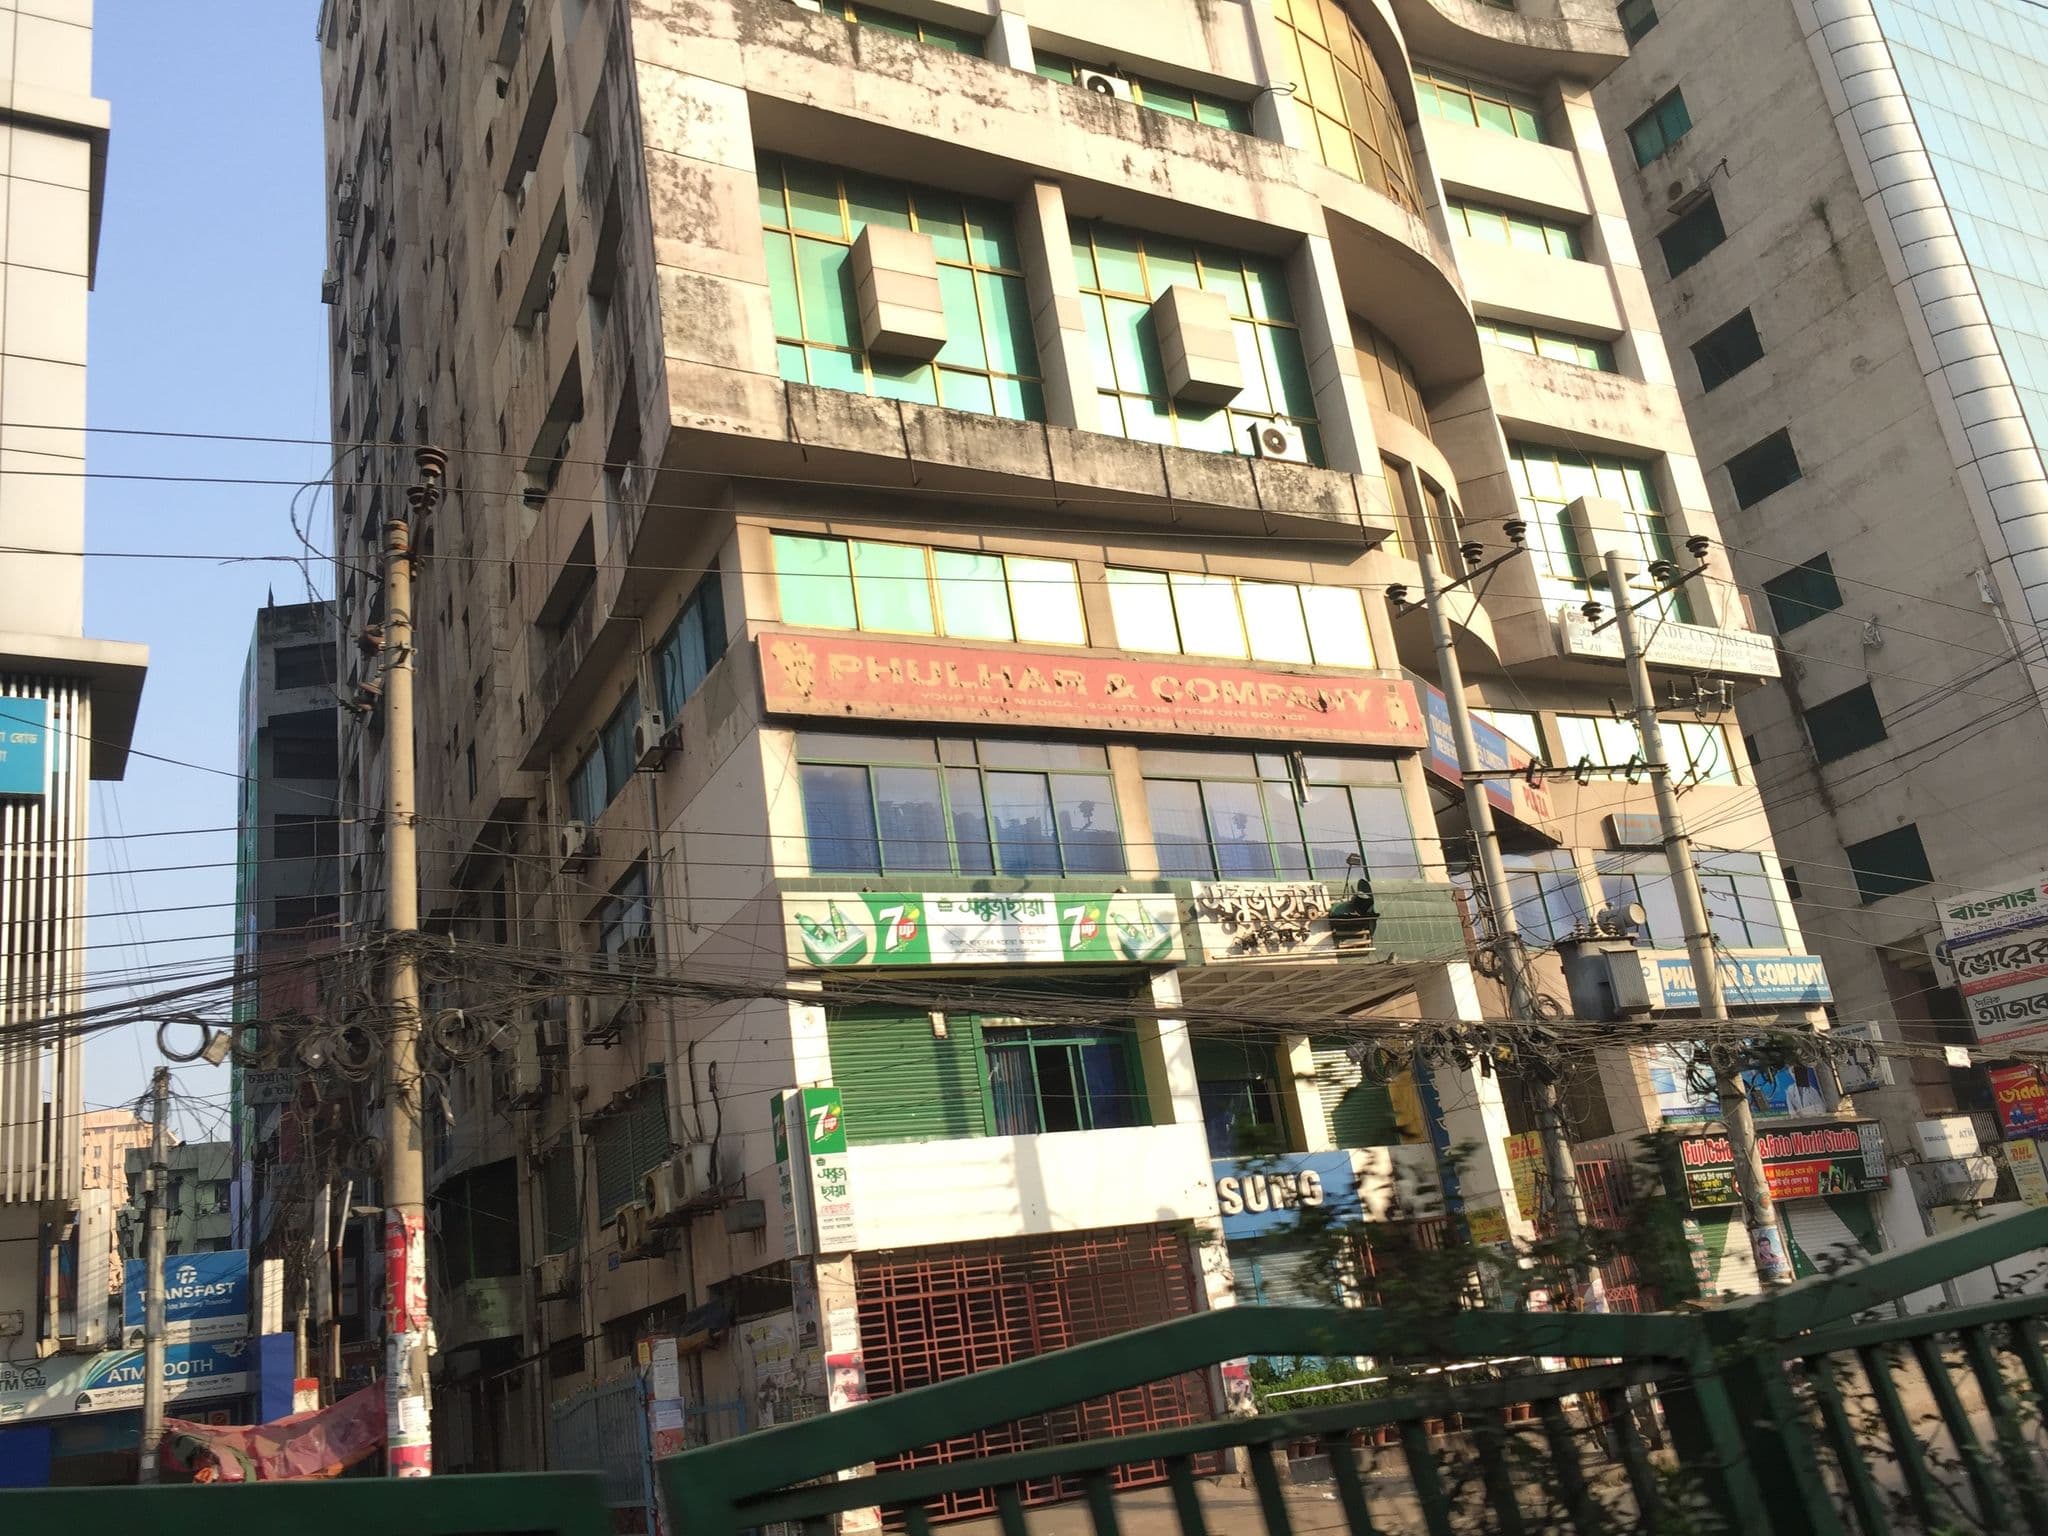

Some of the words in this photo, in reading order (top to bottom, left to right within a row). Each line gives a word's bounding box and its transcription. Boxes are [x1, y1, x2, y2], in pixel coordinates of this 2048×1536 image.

[828, 653, 1089, 696] PHULHAR
[1104, 672, 1138, 699] &
[1150, 675, 1372, 713] COMPANY
[1742, 964, 1755, 988] &
[1756, 961, 1826, 988] COMPANY
[1682, 1138, 1707, 1167] Fuji
[1790, 1130, 1825, 1156] World
[1825, 1127, 1859, 1152] Studio
